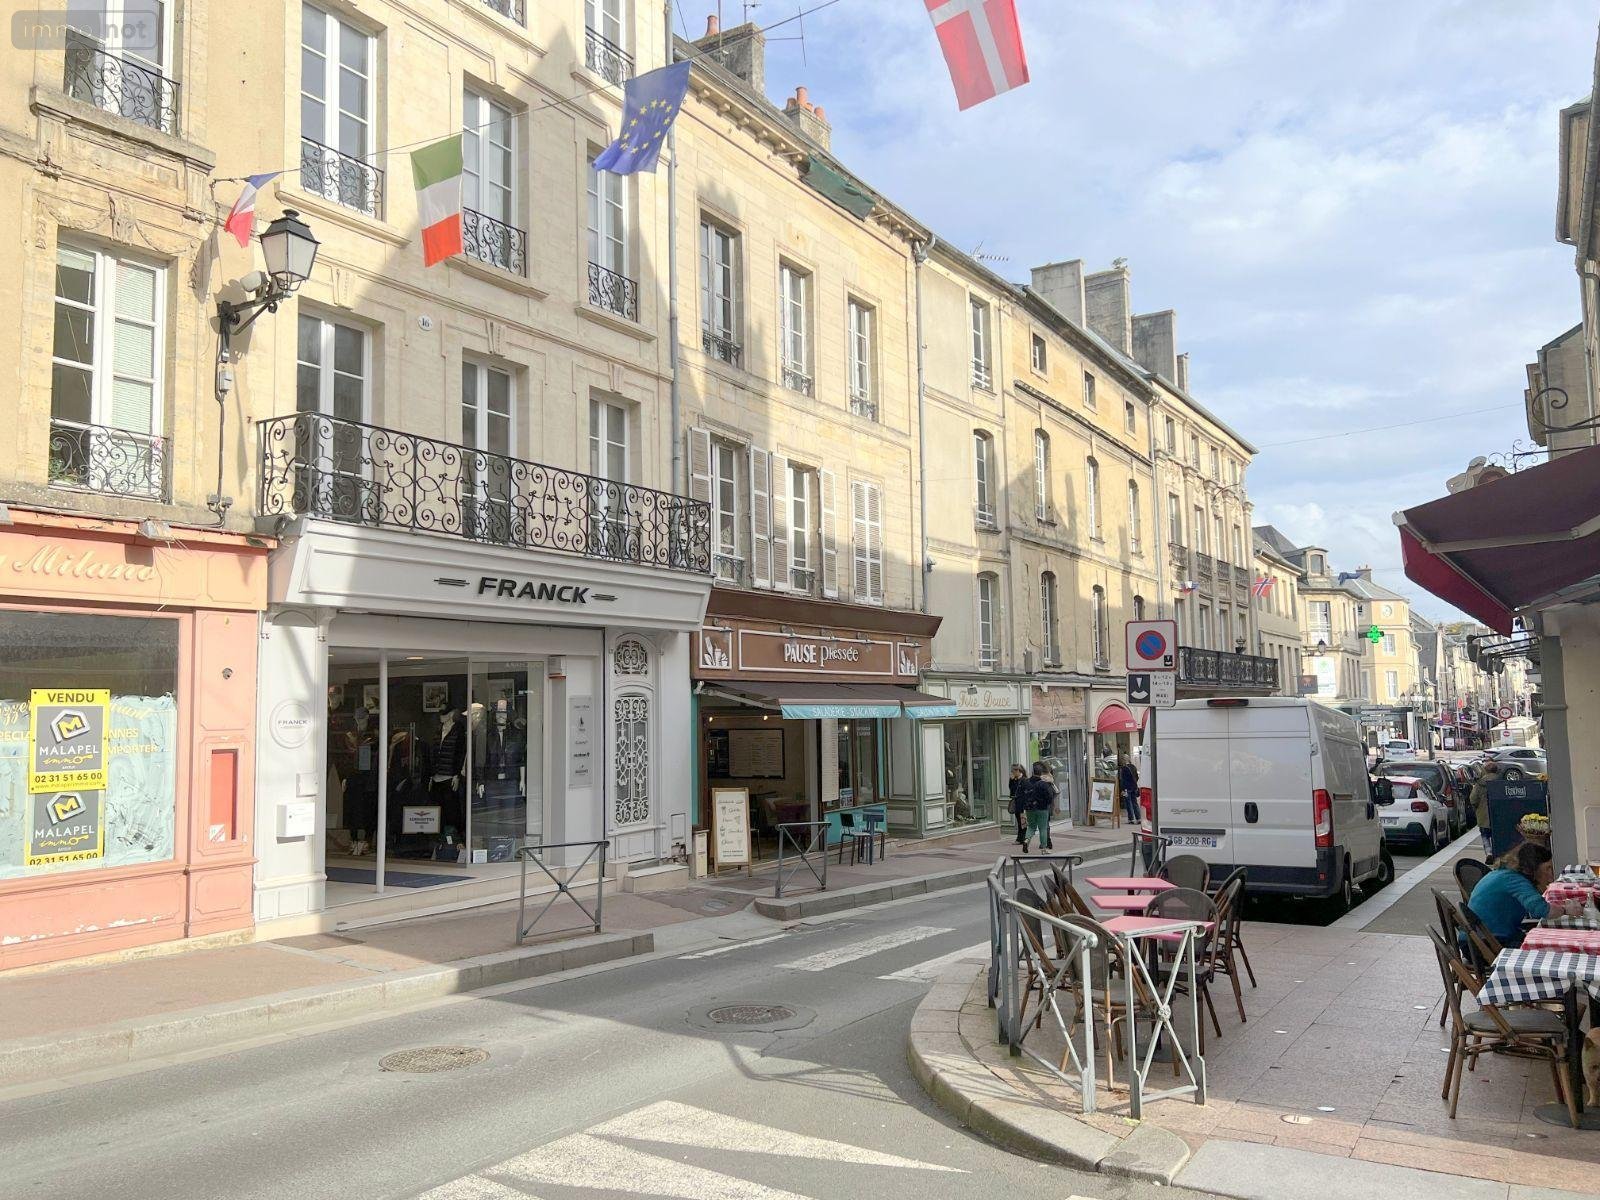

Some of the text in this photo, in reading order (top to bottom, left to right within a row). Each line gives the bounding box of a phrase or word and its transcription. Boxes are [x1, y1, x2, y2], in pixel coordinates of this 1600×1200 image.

[12, 543, 158, 582] Milano
[478, 576, 591, 604] FRANCK
[784, 643, 817, 663] PAUSE
[47, 692, 95, 704] VENDU
[39, 744, 99, 756] MALAPEL
[34, 772, 102, 783] 02 31 51 65 00
[34, 825, 95, 839] MALAPEL
